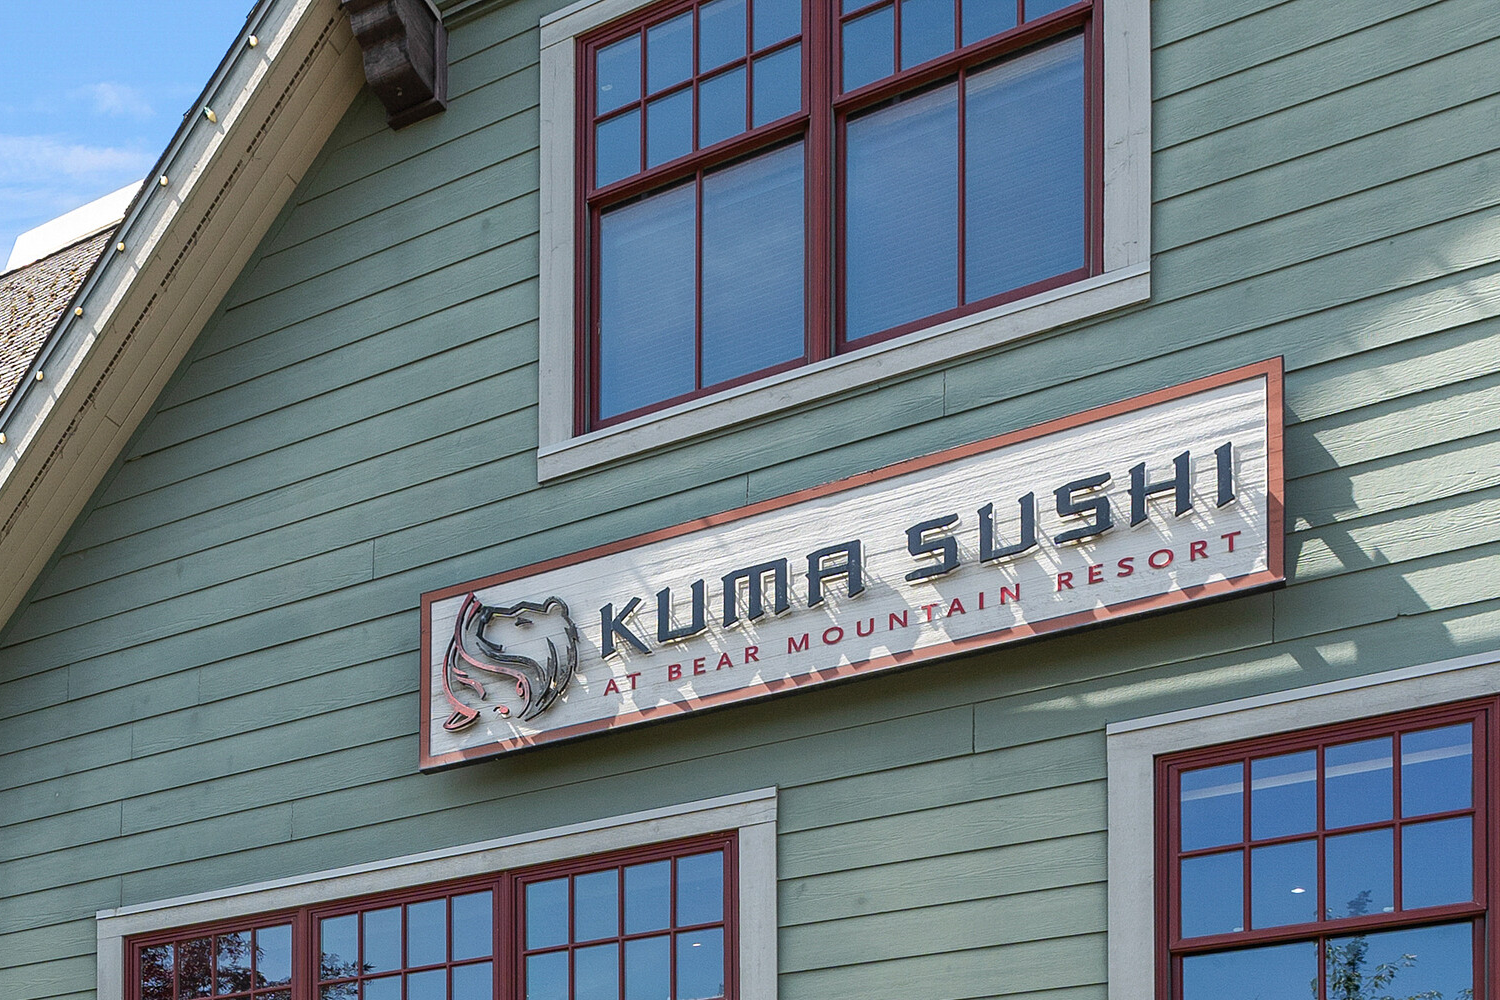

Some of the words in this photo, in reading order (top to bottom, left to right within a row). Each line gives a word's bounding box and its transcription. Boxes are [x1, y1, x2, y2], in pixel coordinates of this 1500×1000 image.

[600, 539, 866, 661] KUMA
[904, 441, 1237, 584] SUSHI
[603, 672, 642, 696] AT
[667, 645, 760, 682] BEAR
[787, 583, 1021, 654] MOUNTAIN
[1056, 531, 1242, 592] RESORT
